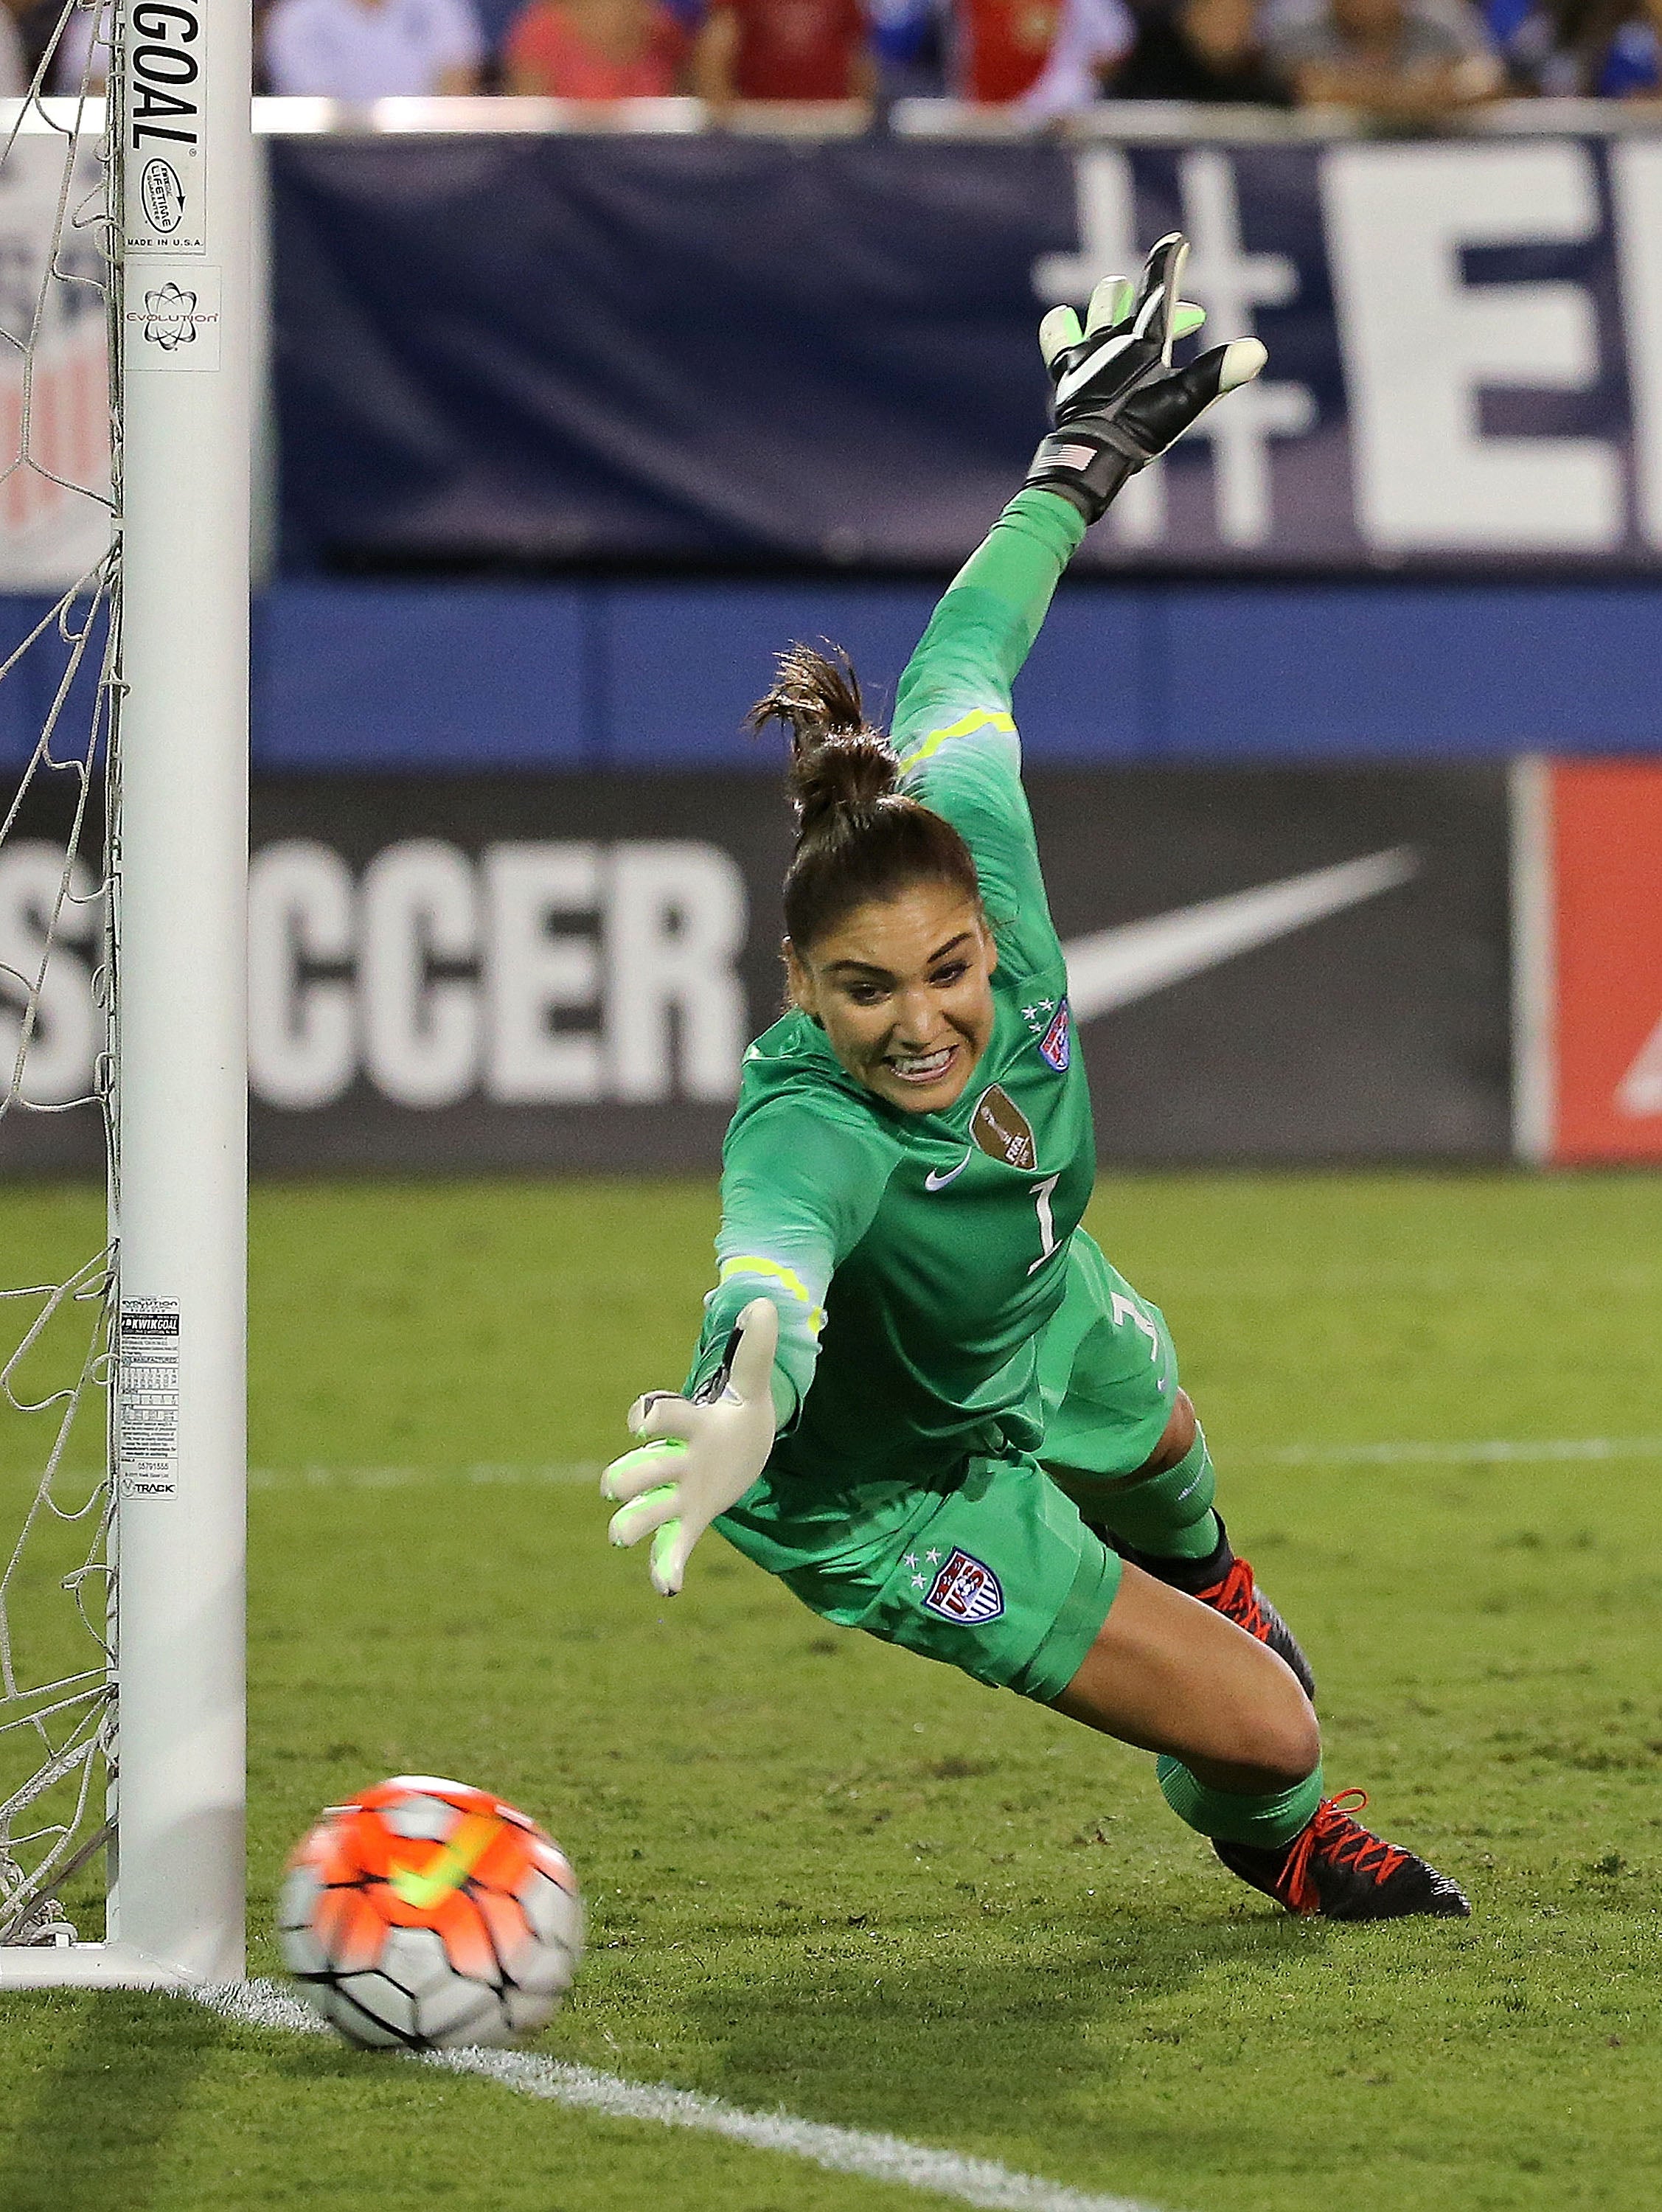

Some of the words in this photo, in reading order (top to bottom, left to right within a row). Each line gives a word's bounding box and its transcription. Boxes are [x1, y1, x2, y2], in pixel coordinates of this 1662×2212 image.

[151, 165, 171, 227] LIFETIME
[0, 839, 747, 1109] SCCER
[1005, 1135, 1025, 1162] FIFA
[1027, 1172, 1063, 1276] 1
